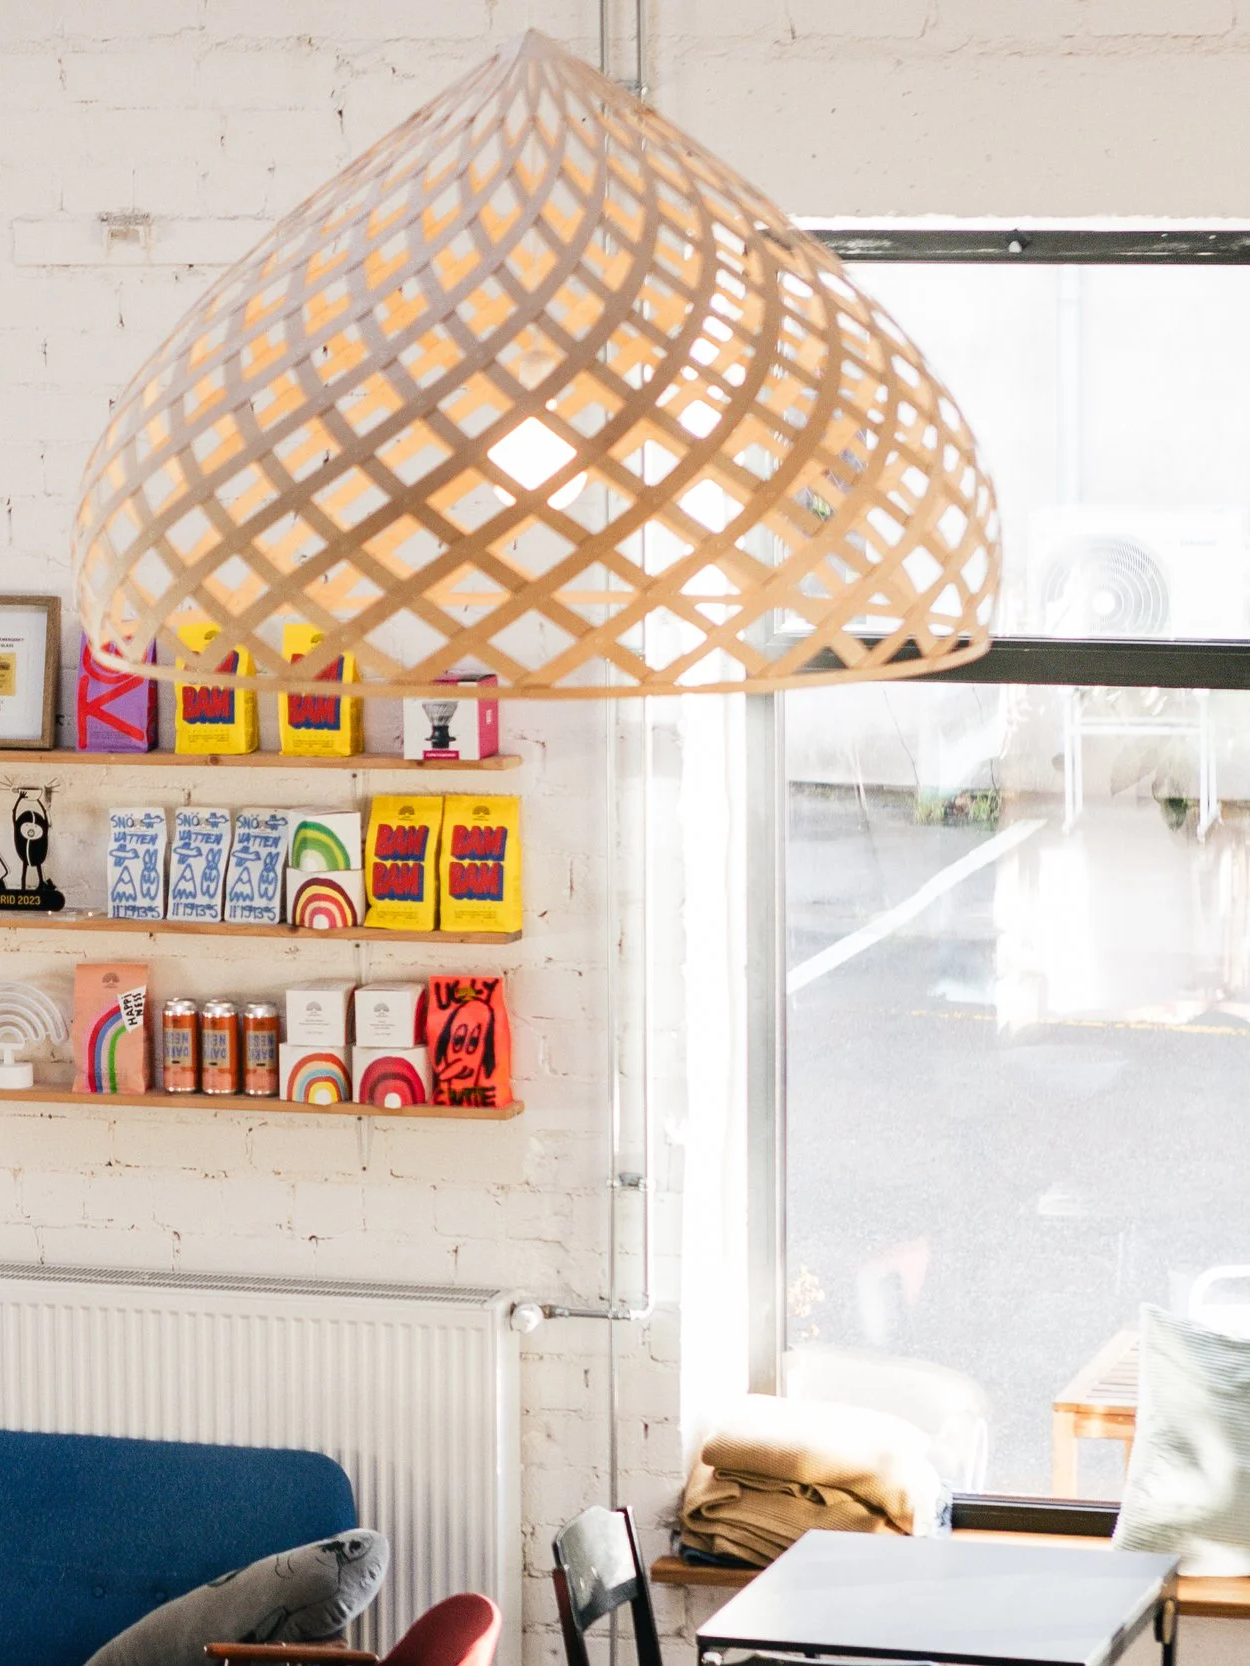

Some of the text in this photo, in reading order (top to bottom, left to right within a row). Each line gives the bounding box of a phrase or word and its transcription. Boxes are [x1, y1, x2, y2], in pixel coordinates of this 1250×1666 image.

[110, 813, 135, 828] SNÖ
[176, 811, 200, 826] SNÖ
[236, 814, 259, 829] SNÖ
[374, 824, 430, 862] BAM
[451, 824, 508, 862] BAM
[372, 861, 424, 902] BAM
[449, 861, 504, 902] BAM
[18, 895, 41, 905] 2023
